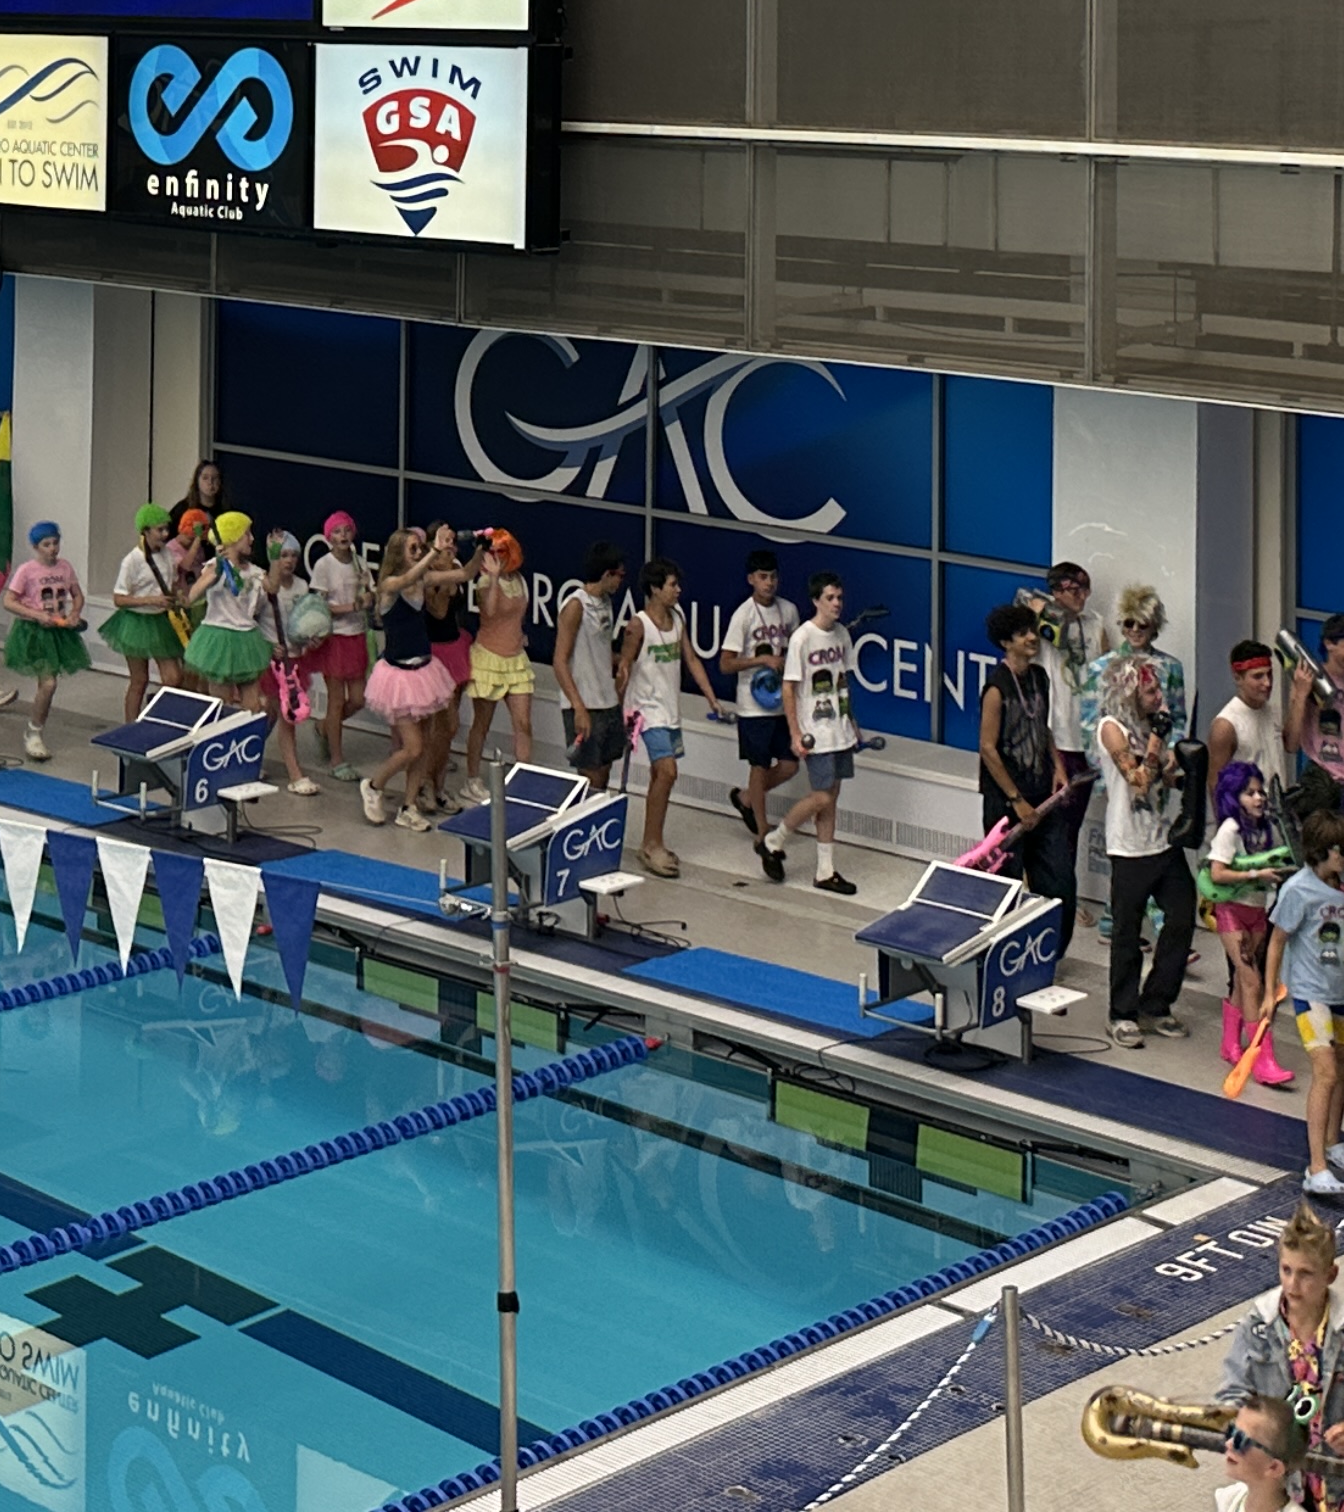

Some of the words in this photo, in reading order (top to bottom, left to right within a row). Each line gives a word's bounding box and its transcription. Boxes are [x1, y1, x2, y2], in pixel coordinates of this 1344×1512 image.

[358, 55, 482, 100] SWIM
[375, 96, 462, 141] GSA
[12, 139, 57, 156] AQUATIC
[60, 141, 99, 158] CENTER
[8, 159, 35, 187] TO
[42, 160, 98, 192] SWIM
[147, 169, 269, 210] enfinity
[171, 201, 214, 219] Aquatic
[217, 205, 243, 221] Club
[454, 328, 847, 543] GAC
[202, 734, 261, 772] GAC
[194, 778, 209, 803] 6
[563, 818, 622, 860] GAC
[556, 868, 570, 897] 7
[999, 927, 1056, 976] GAC
[992, 986, 1006, 1017] 8
[1154, 1240, 1244, 1282] 9FT
